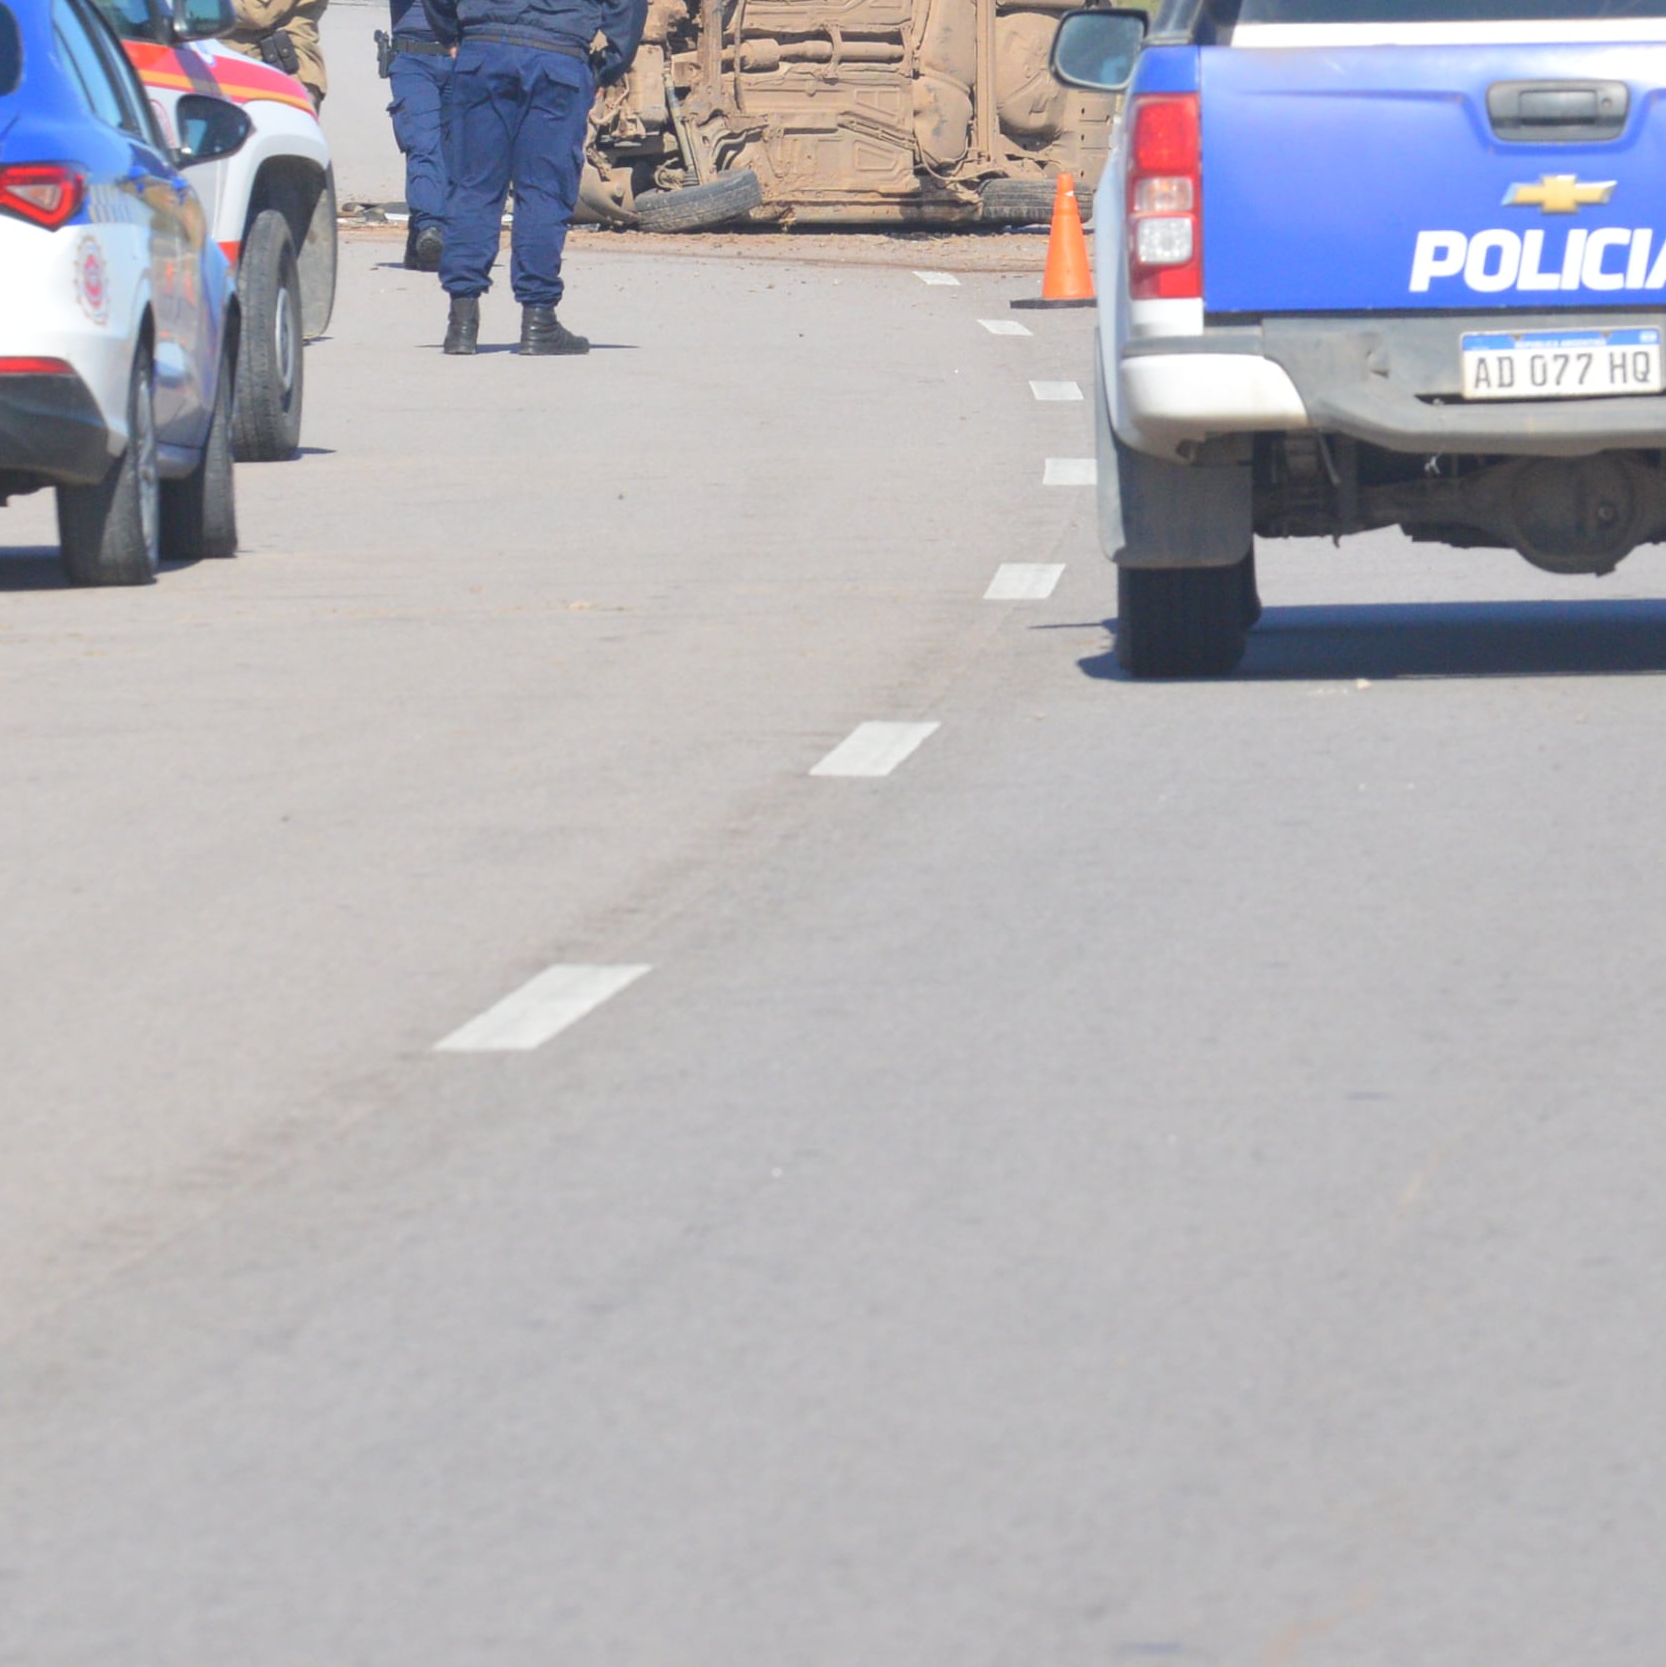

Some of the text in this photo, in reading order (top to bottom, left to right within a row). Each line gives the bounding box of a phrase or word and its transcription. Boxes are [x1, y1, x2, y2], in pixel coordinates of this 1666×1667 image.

[1474, 351, 1651, 389] AD 077 HQ
